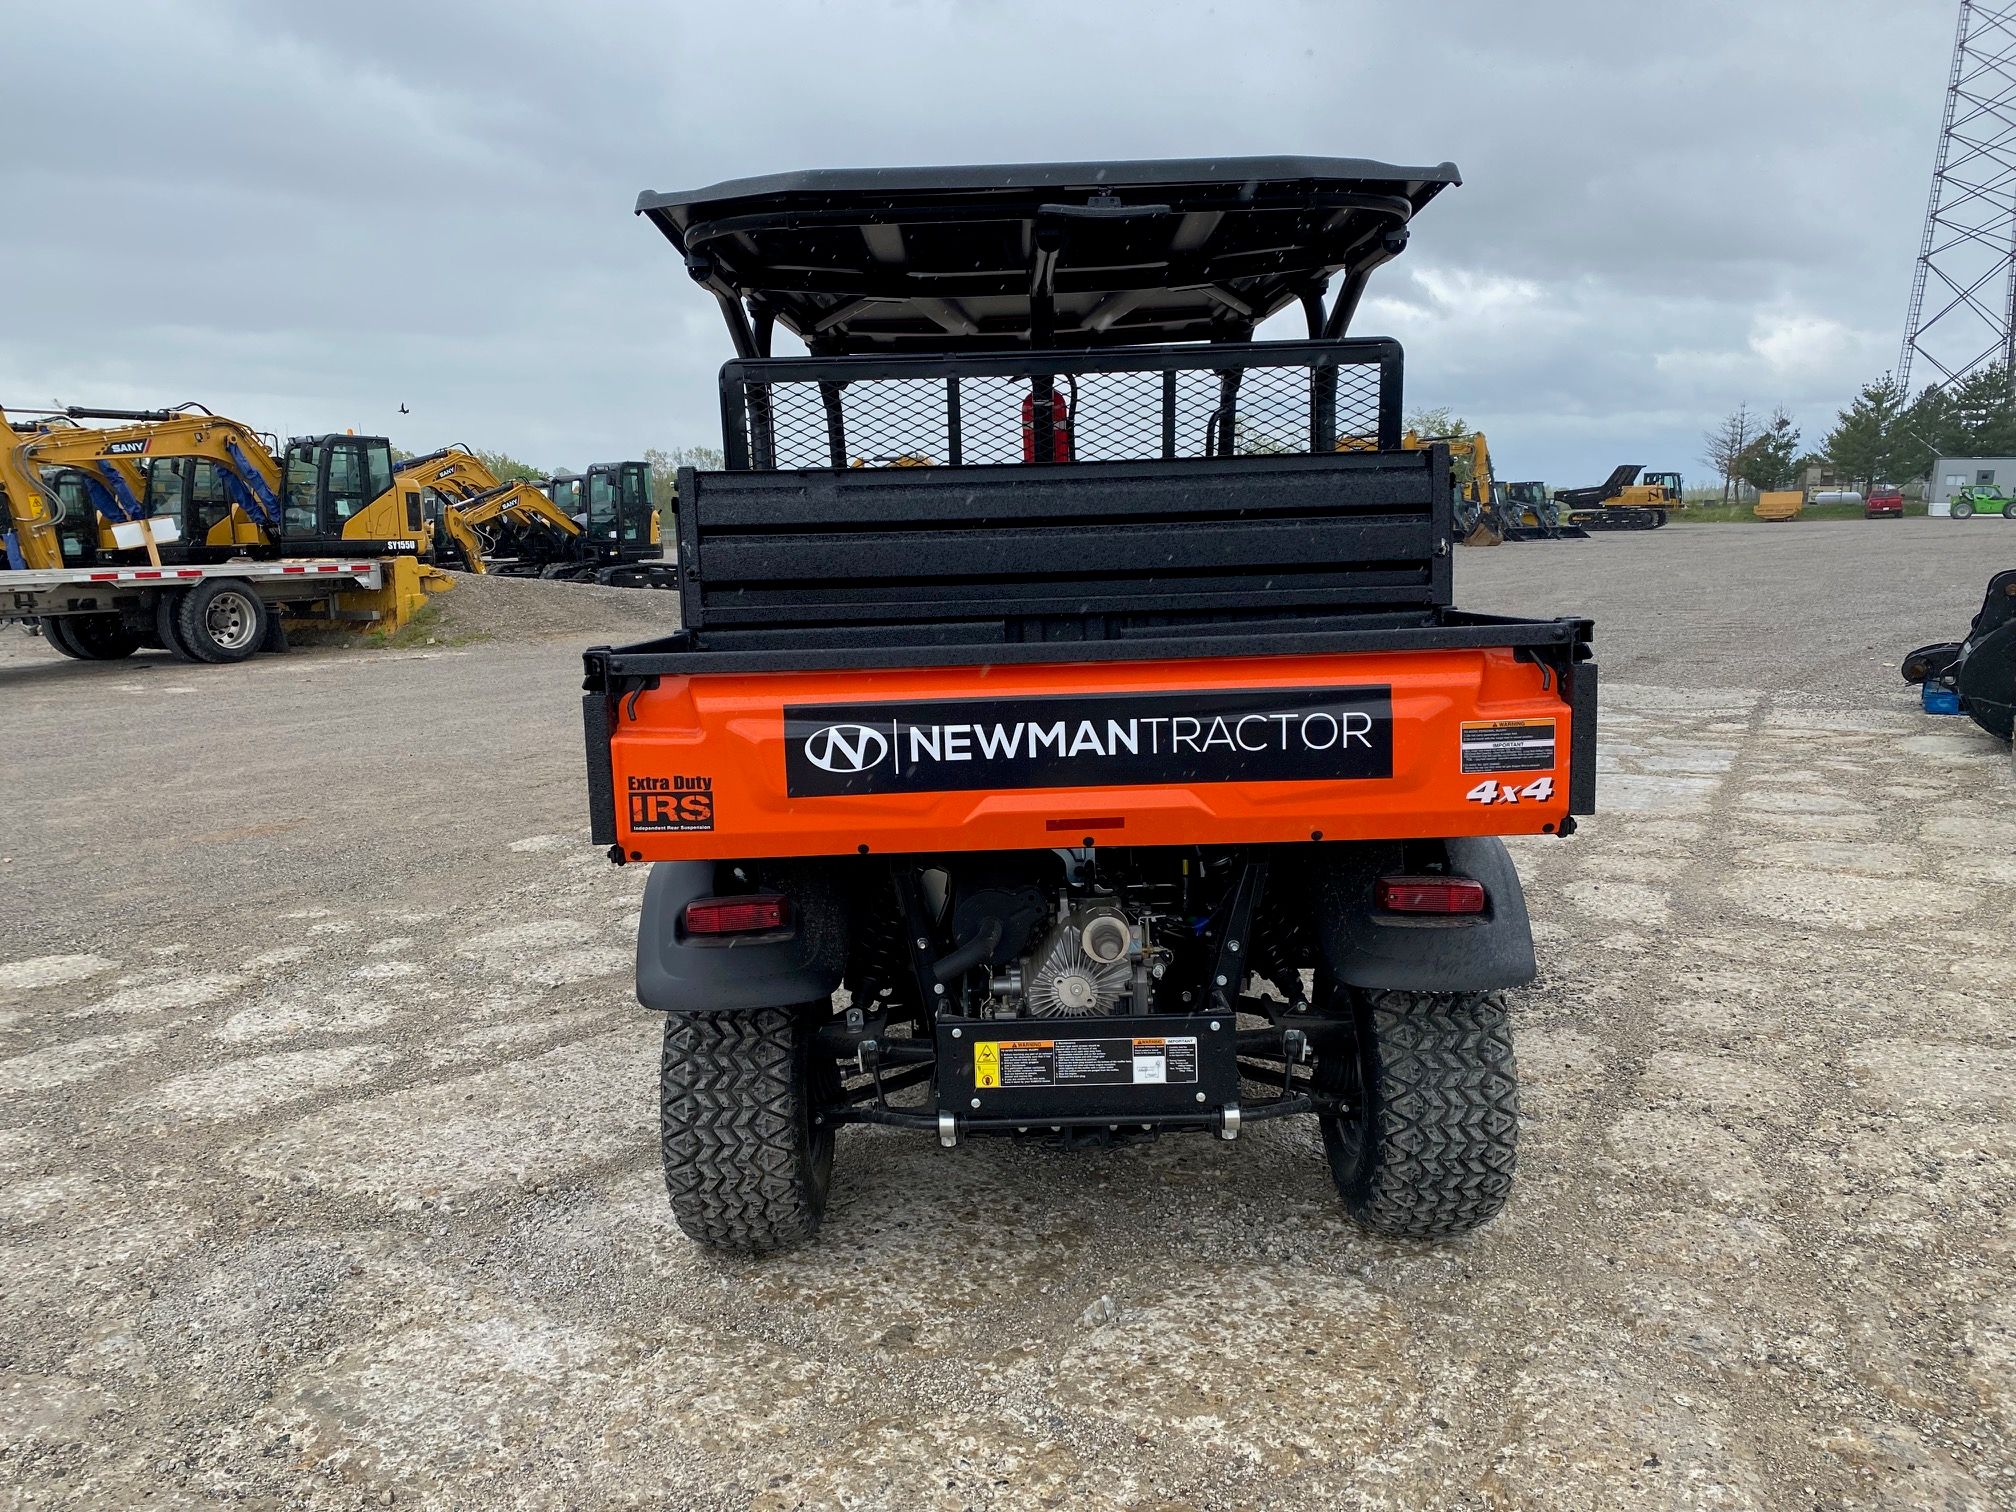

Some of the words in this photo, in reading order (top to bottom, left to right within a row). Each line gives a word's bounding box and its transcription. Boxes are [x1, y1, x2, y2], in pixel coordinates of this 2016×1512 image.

[111, 442, 143, 453] SANY
[387, 541, 416, 550] SY155U
[628, 776, 670, 791] Extra
[673, 775, 712, 791] Duty
[1465, 777, 1554, 804] 4x4
[632, 795, 711, 822] IRS
